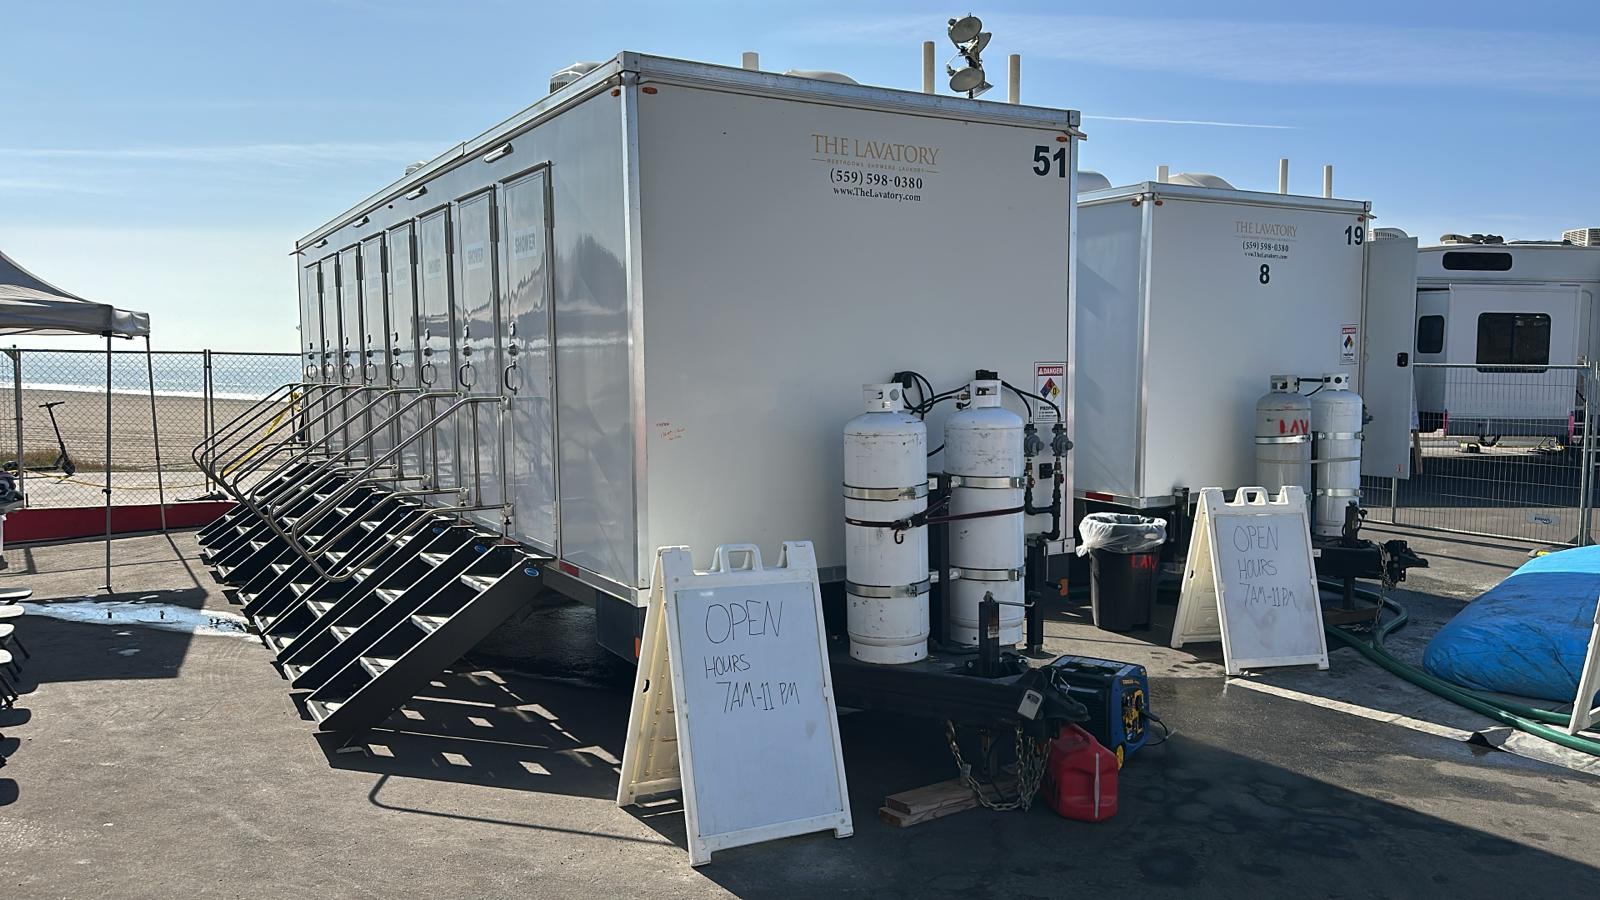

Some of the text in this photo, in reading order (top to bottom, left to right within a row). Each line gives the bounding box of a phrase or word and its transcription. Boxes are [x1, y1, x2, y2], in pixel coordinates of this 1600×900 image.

[811, 134, 940, 166] THE LAVATORY
[1033, 145, 1066, 178] 51
[830, 168, 923, 190] (559) 598-0380
[833, 186, 921, 202] www.TheLavatory.com
[1235, 221, 1298, 237] THE LAVATORY
[1344, 225, 1364, 246] 19
[1242, 240, 1260, 250] (559)
[1259, 263, 1270, 285] 8
[1043, 367, 1063, 375] DANGER
[1233, 525, 1279, 552] OPEN
[1238, 557, 1278, 579] HOURS
[705, 599, 784, 644] OPEN
[703, 653, 751, 679] HOURS
